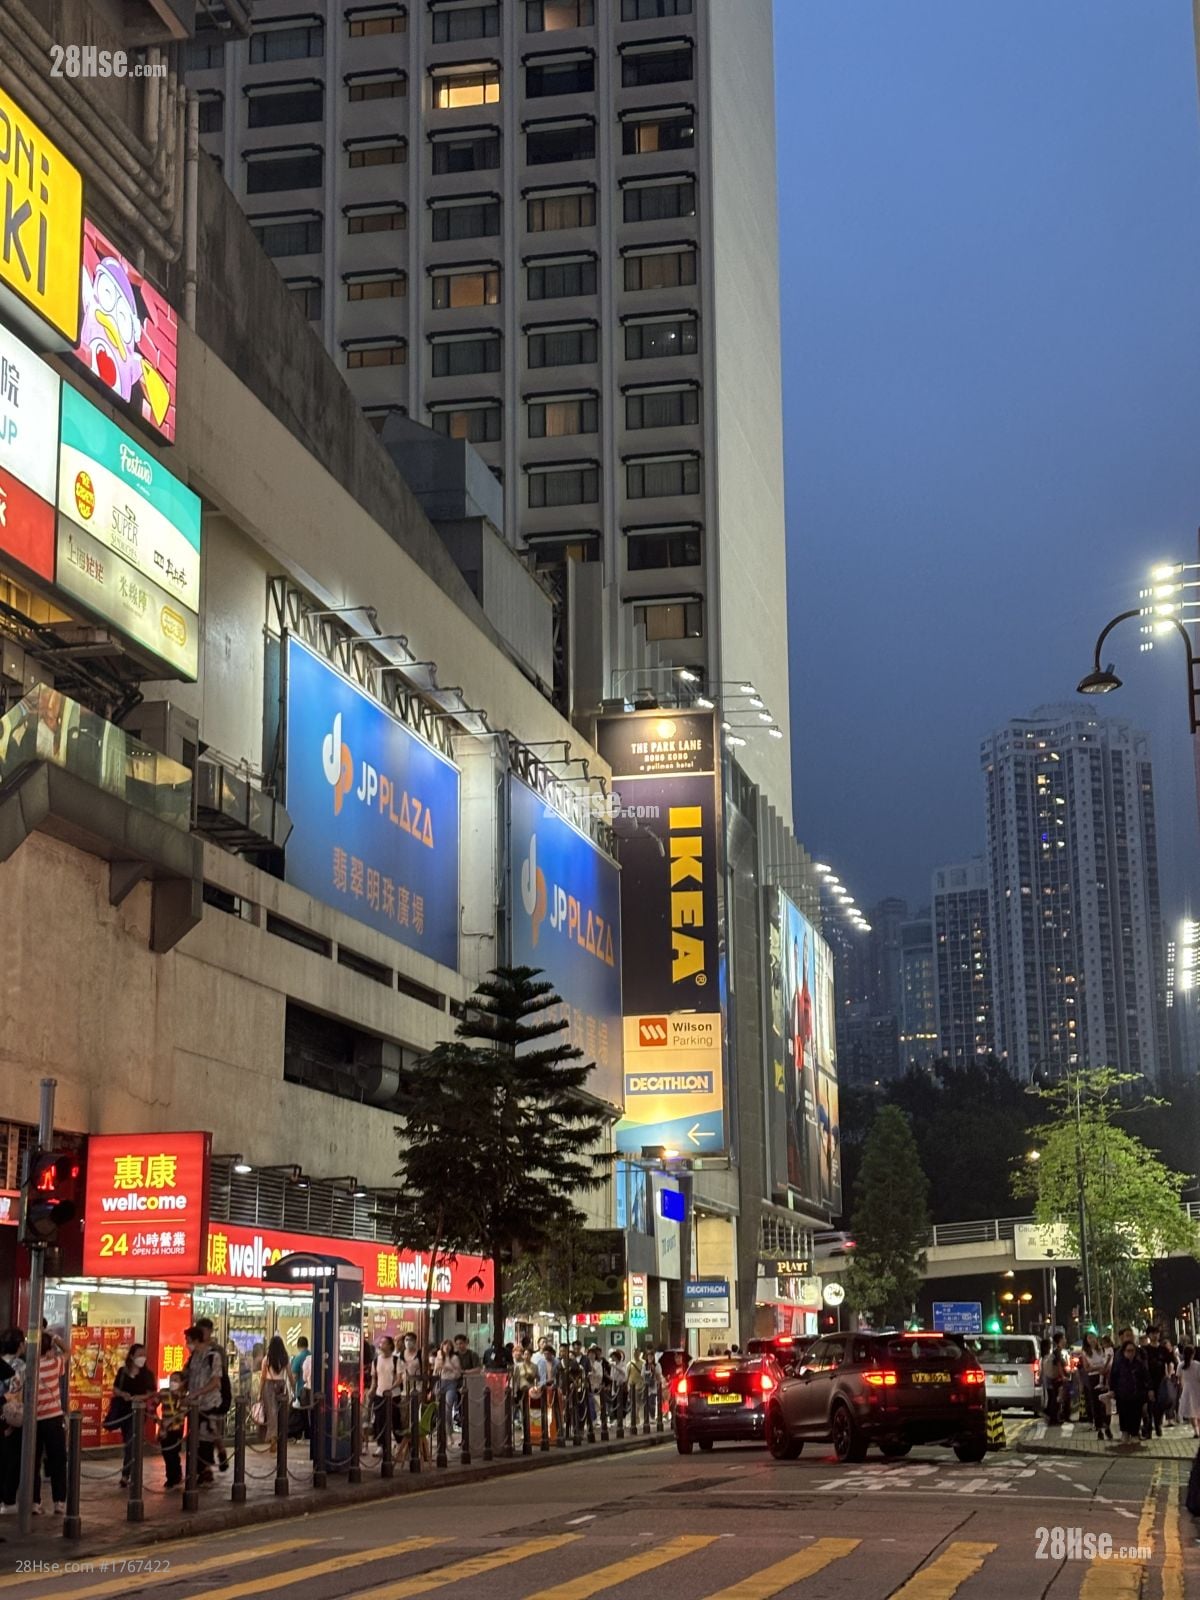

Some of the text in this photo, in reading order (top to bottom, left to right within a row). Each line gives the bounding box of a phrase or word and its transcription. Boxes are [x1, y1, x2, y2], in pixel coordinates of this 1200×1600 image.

[111, 510, 138, 546] SUPER
[631, 740, 702, 754] THE PARK LANE
[676, 760, 694, 768] hotel
[379, 773, 433, 849] PLAZA
[669, 806, 704, 983] IKEA
[568, 895, 614, 968] PLAZA
[672, 1022, 712, 1032] Wilson
[673, 1035, 713, 1047] Parking
[629, 1075, 709, 1092] DECATHLON
[113, 1153, 177, 1189] 惠康
[102, 1193, 187, 1211] wellcome
[99, 1232, 186, 1256] 24 小時營業
[161, 1247, 185, 1255] HOURS
[377, 1252, 398, 1288] 惠康
